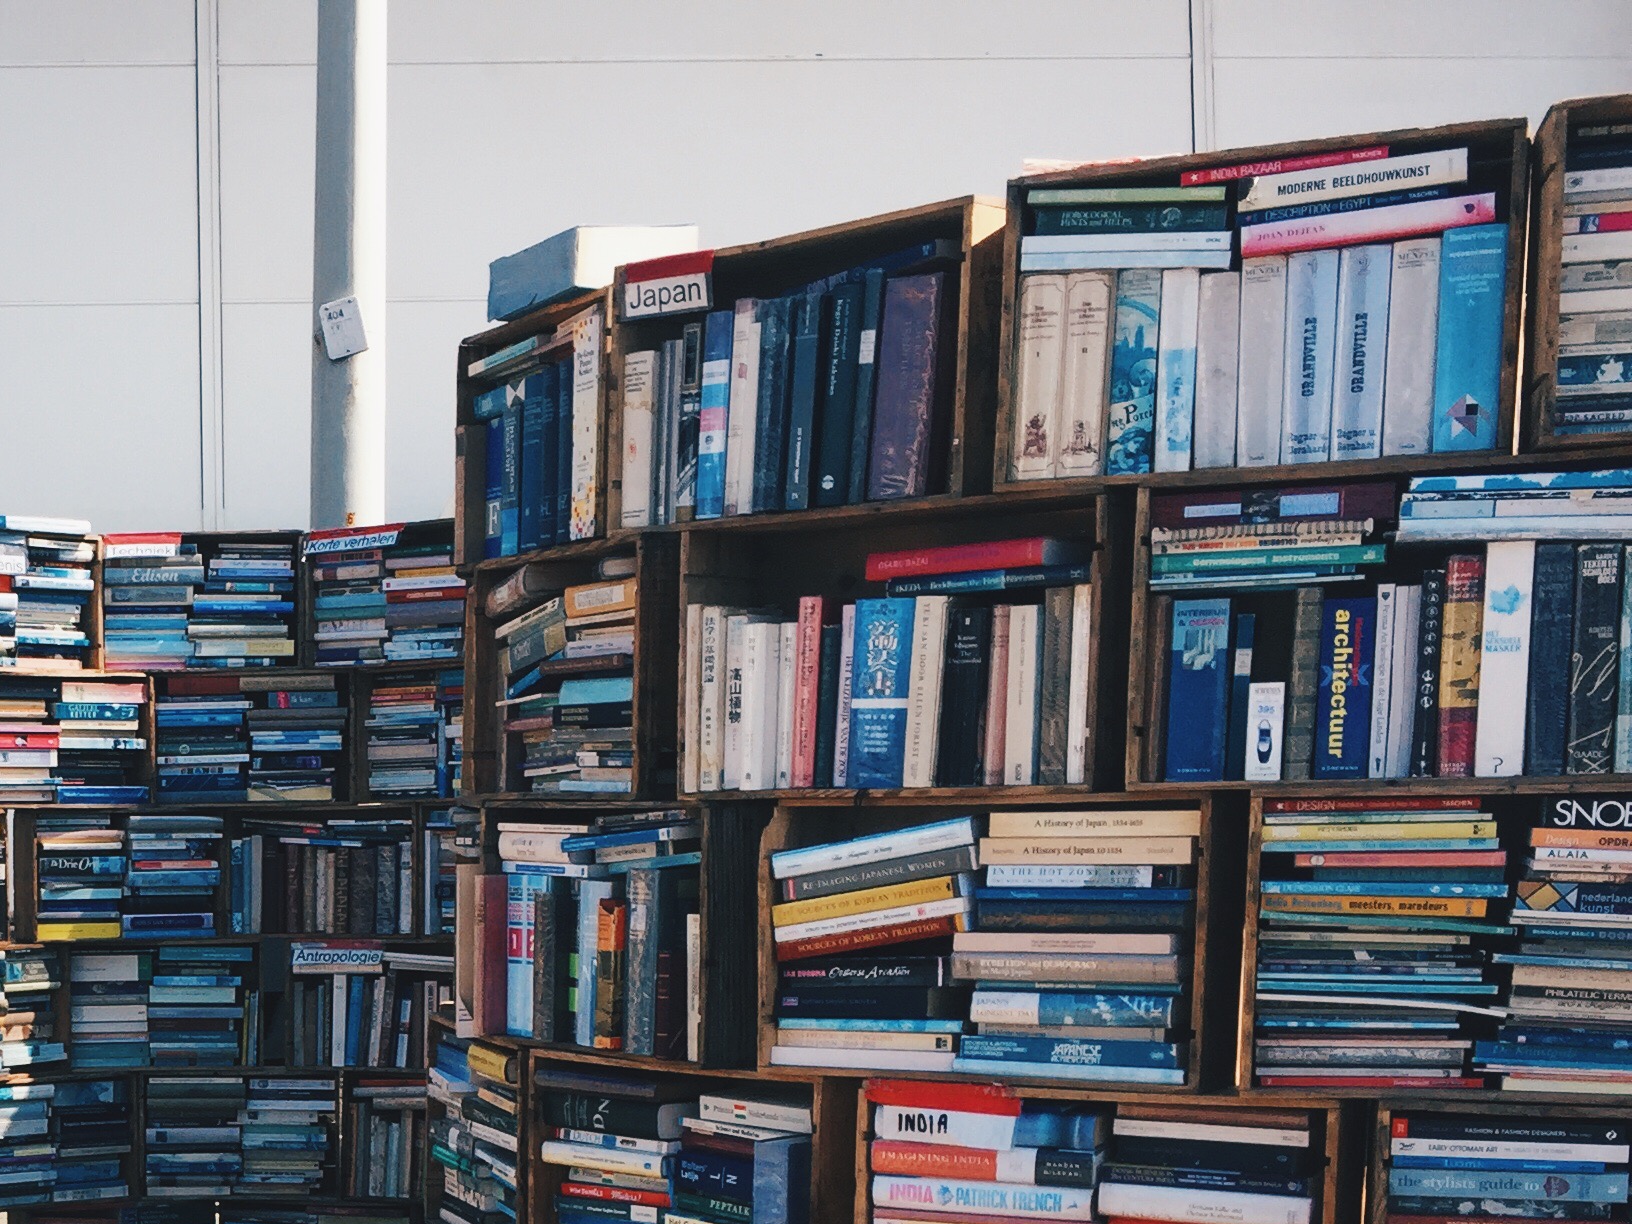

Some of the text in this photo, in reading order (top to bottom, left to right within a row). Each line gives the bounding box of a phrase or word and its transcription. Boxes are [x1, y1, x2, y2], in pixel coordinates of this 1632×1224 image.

[1277, 164, 1431, 196] MODERNE BEELDHOUWKUNST
[628, 280, 703, 312] Japan
[1301, 316, 1318, 398] GRANDVILLE
[1351, 312, 1369, 395] GRANDVILLE
[342, 534, 396, 551] verhalen
[131, 568, 179, 583] Edison
[1326, 608, 1351, 758] architectuur
[1296, 801, 1336, 811] DESIGN
[1034, 819, 1042, 828] A
[1075, 818, 1084, 828] of
[1085, 818, 1108, 830] Japan
[1022, 847, 1030, 855] A
[1063, 846, 1072, 856] of
[1073, 846, 1095, 858] Japan
[1011, 866, 1032, 876] THE
[1039, 866, 1063, 876] HOT
[892, 884, 943, 899] TRADITION
[1579, 902, 1616, 915] kunst
[839, 937, 851, 947] OF
[892, 922, 941, 937] TRADITION
[295, 950, 380, 965] Antropologie
[897, 1113, 949, 1135] INDIA
[880, 1151, 991, 1166] IMAGINING INDIA
[1397, 1175, 1421, 1188] the
[1478, 1177, 1524, 1193] guide
[1524, 1180, 1541, 1192] to
[889, 1183, 935, 1205] INDIA
[955, 1186, 1010, 1207] PATRICK
[708, 1199, 751, 1217] PEPTALK
